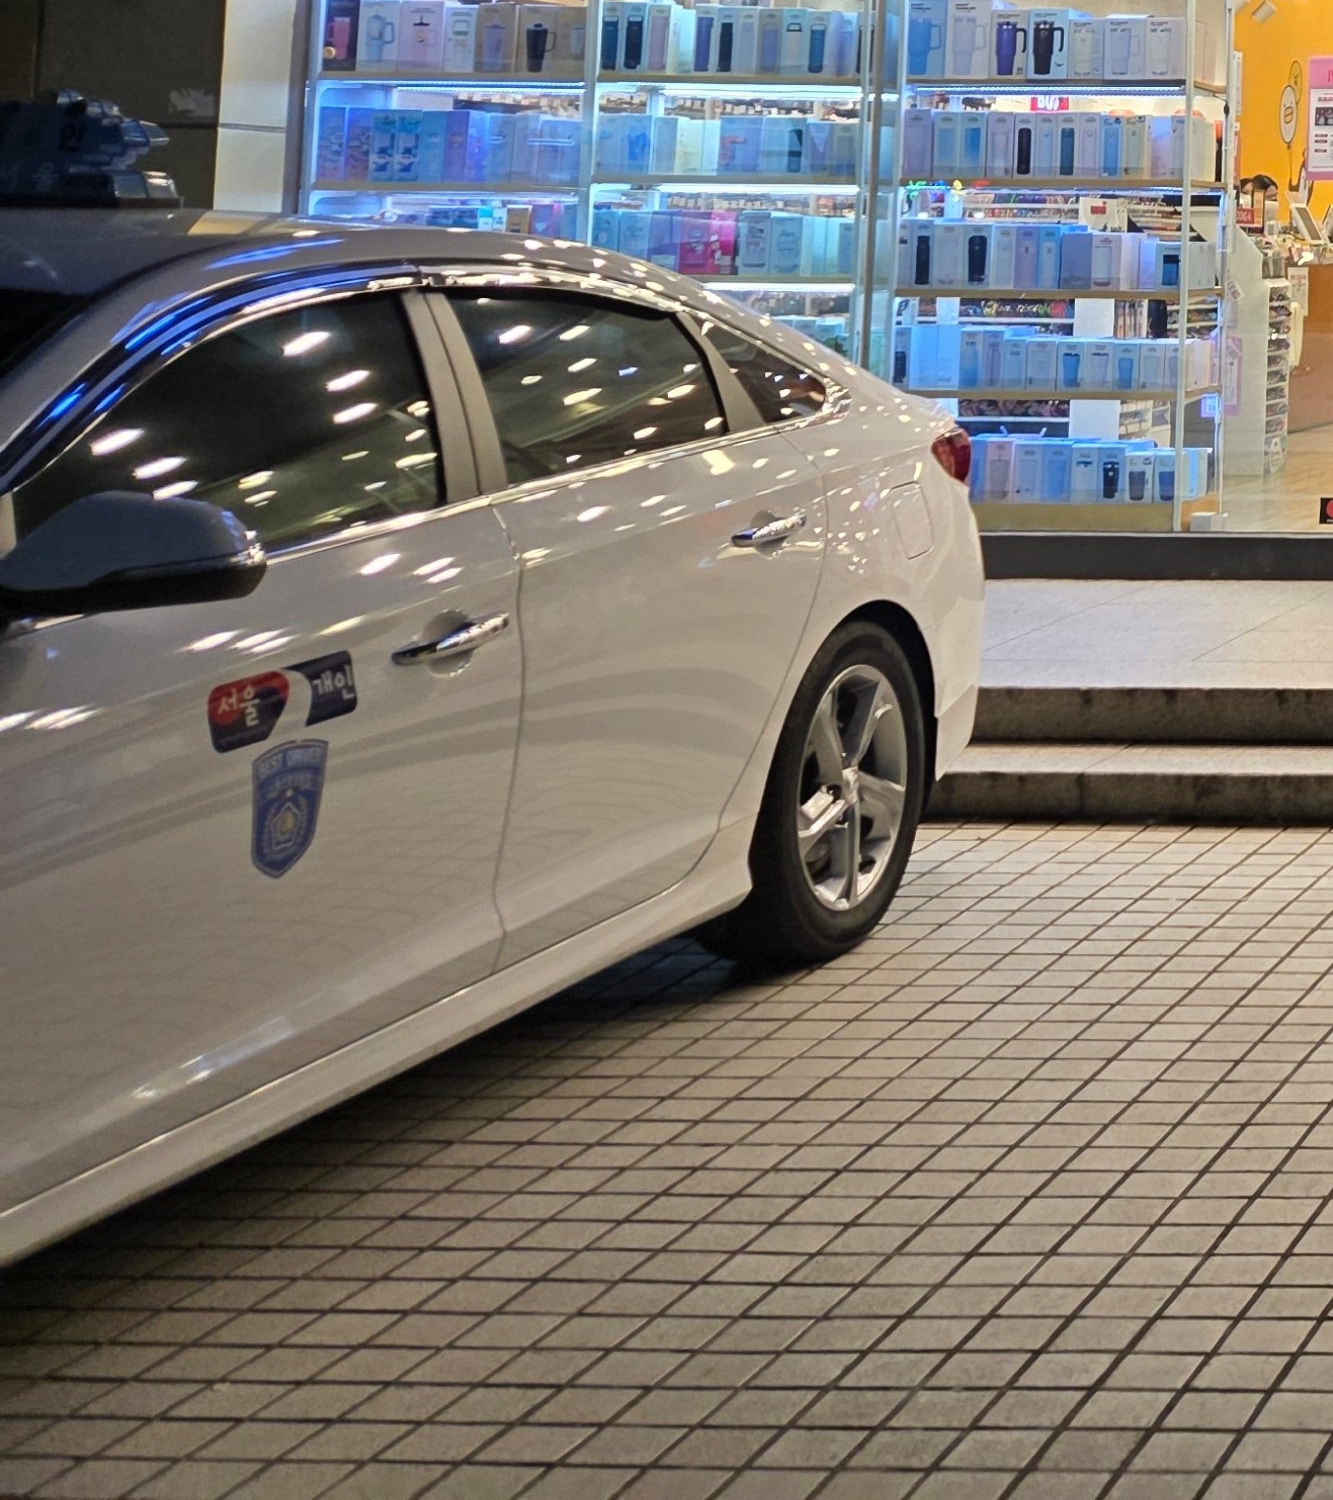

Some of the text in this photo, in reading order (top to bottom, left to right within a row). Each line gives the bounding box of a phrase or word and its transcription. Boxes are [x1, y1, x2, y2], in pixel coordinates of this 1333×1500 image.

[312, 664, 355, 700] 개인
[218, 685, 260, 728] 서울
[257, 752, 284, 780] BEST
